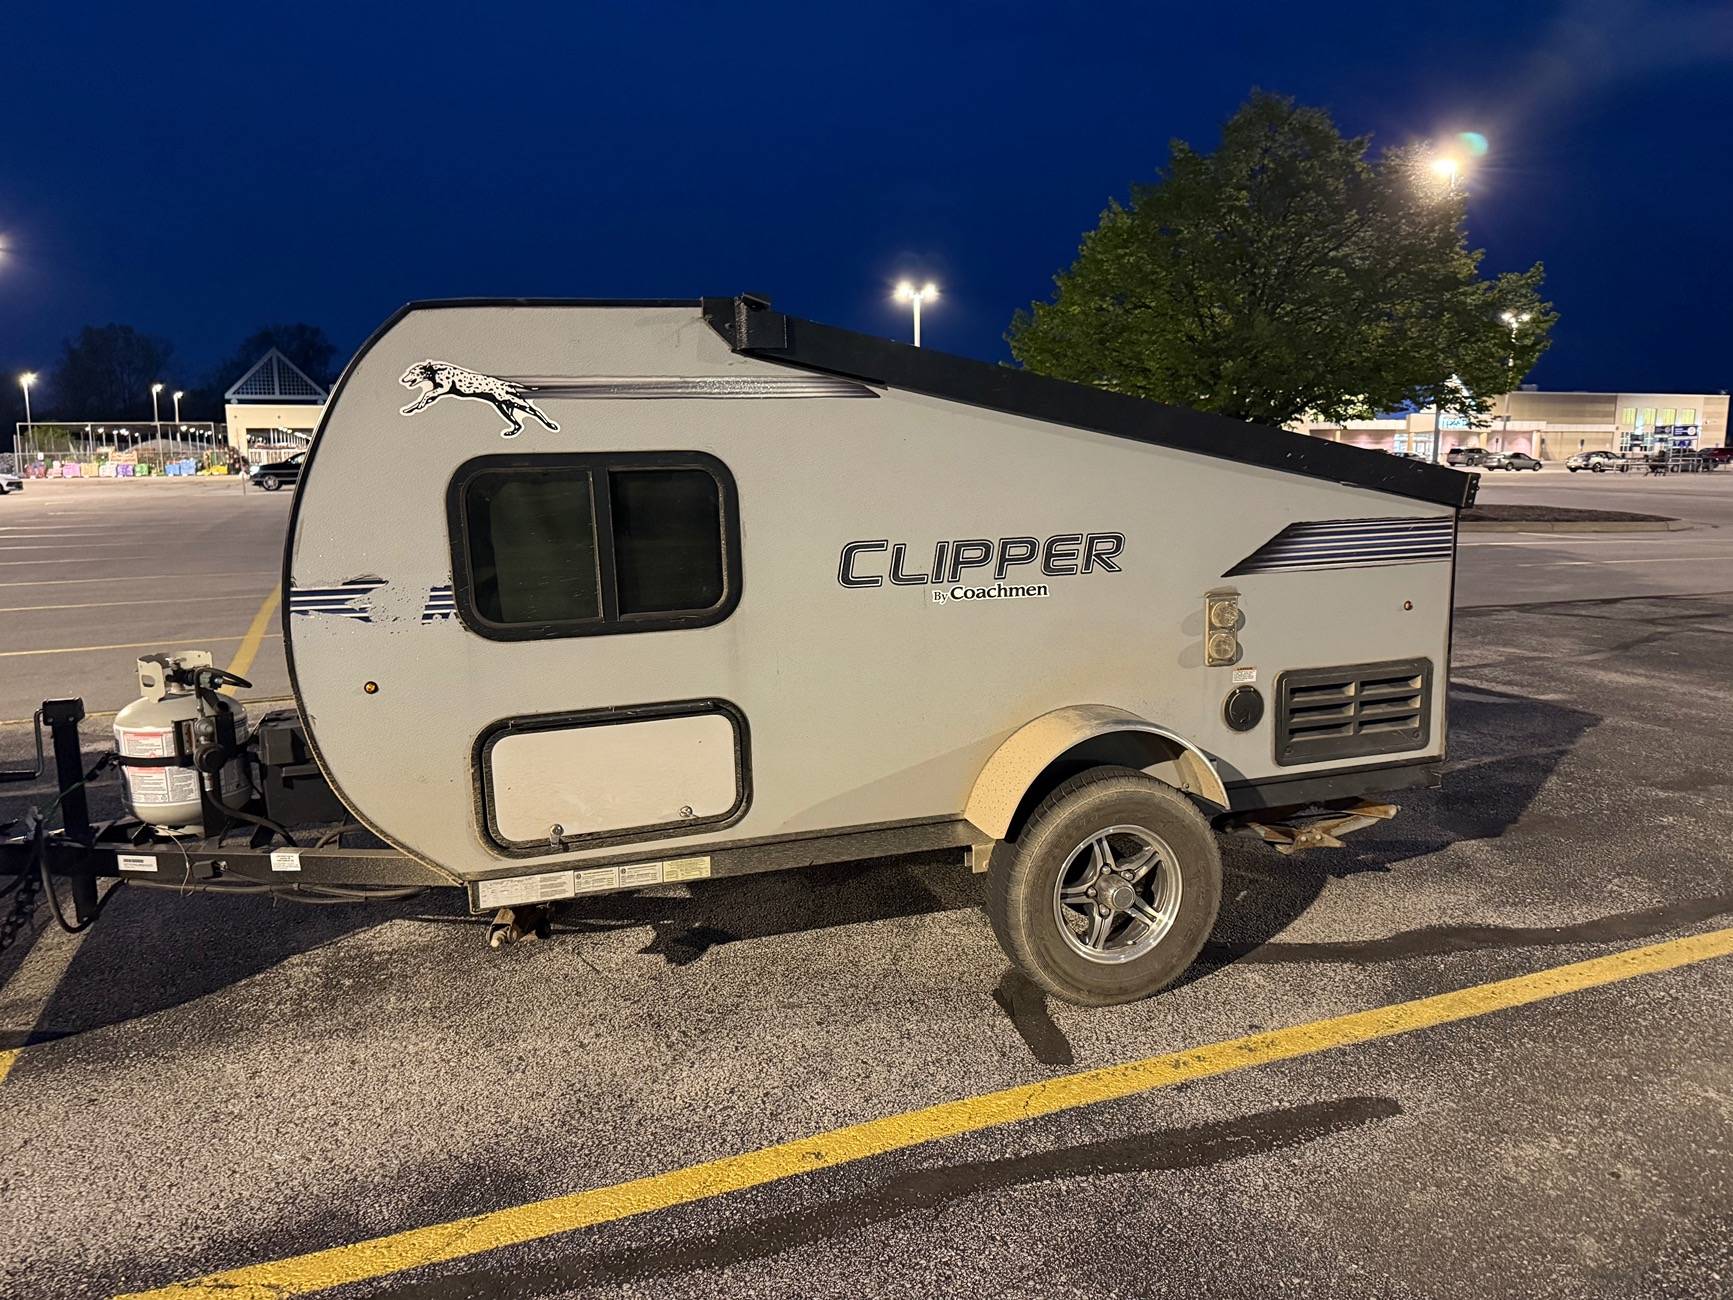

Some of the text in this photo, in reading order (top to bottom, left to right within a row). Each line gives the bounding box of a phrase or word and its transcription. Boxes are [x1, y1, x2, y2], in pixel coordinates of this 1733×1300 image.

[838, 531, 1126, 588] CLIPPER
[934, 583, 1048, 603] By Coachmen
